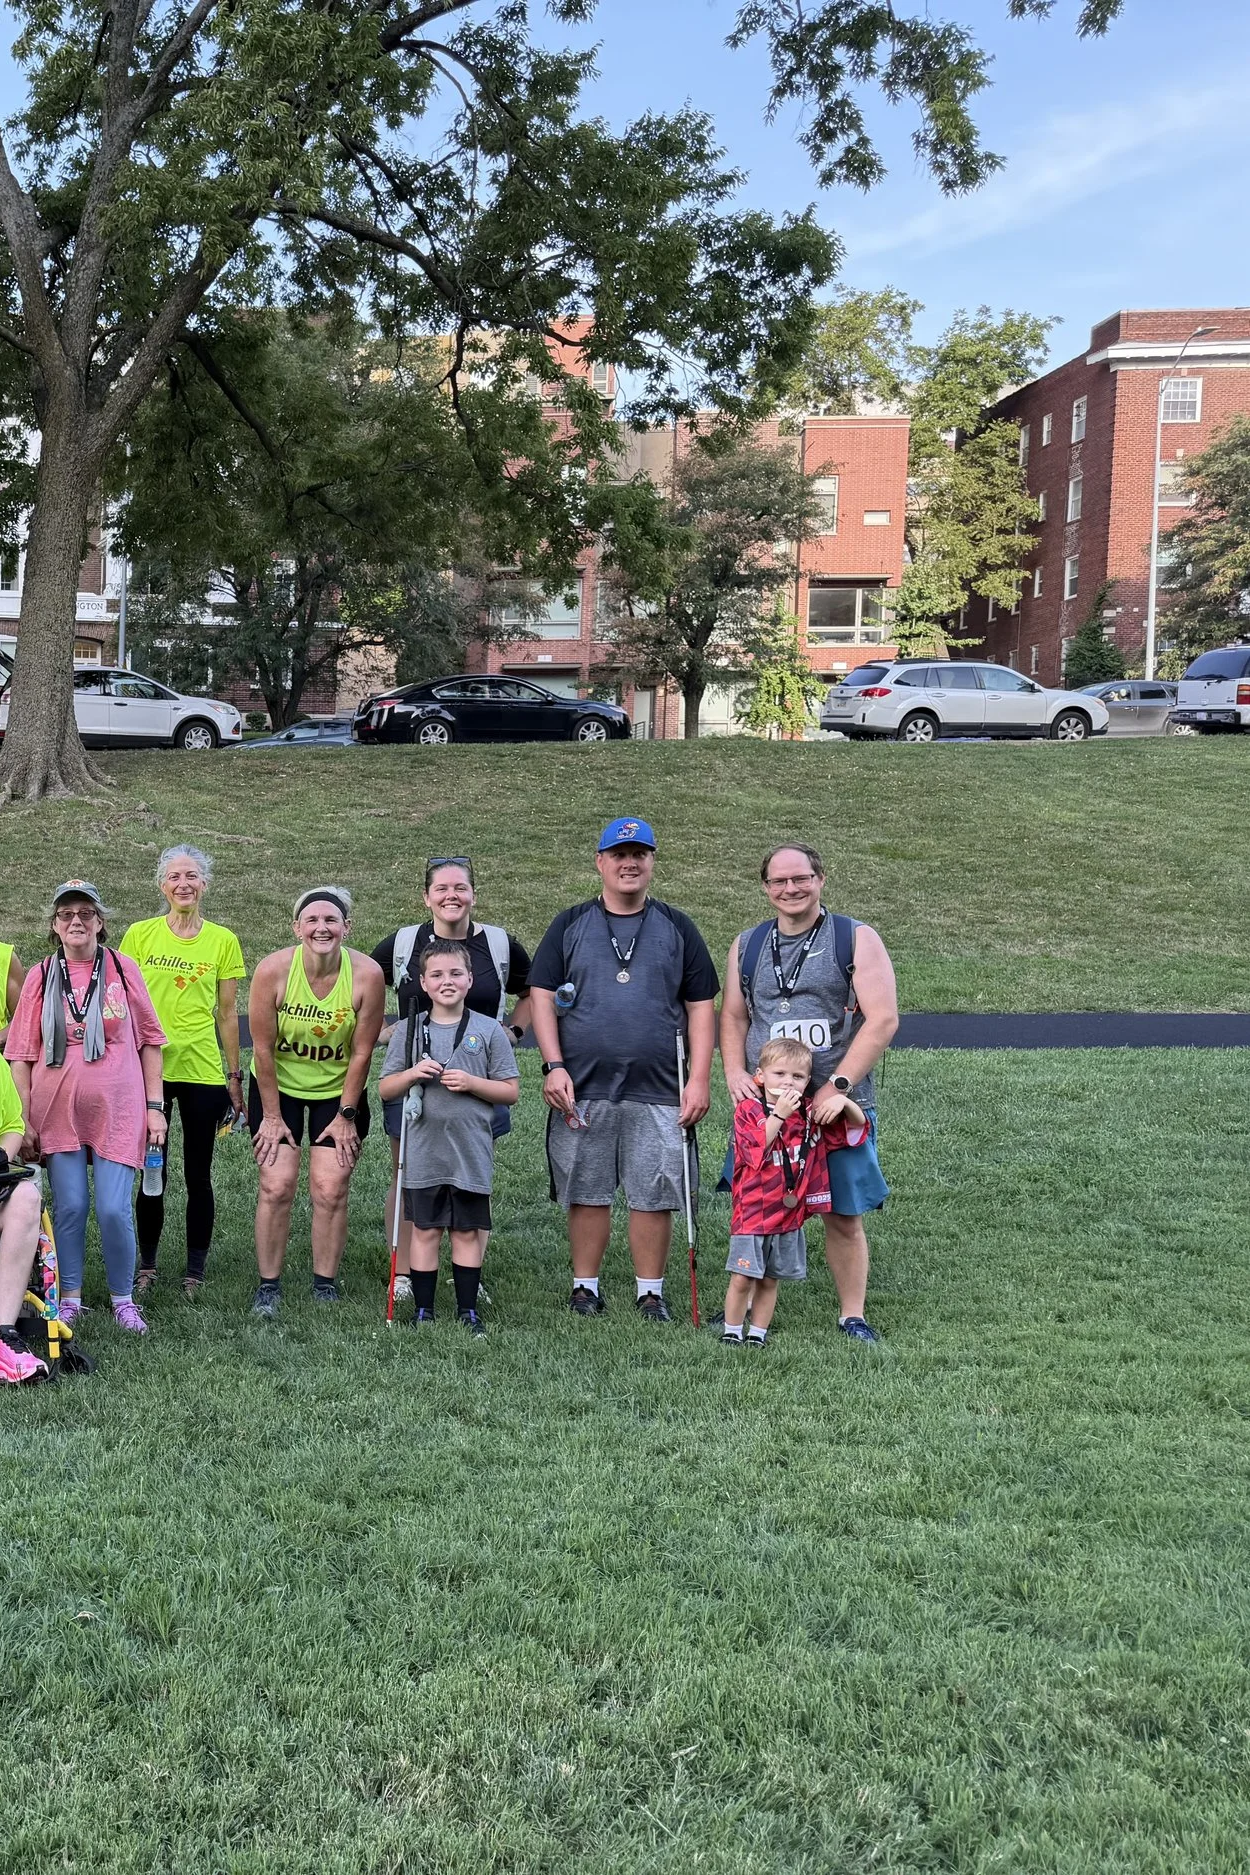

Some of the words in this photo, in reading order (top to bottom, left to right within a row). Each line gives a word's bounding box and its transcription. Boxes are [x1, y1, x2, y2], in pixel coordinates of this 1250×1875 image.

[145, 954, 195, 971] Achilles
[279, 1003, 333, 1021] Achilles
[777, 1023, 826, 1047] 110
[278, 1037, 344, 1062] GUIDE
